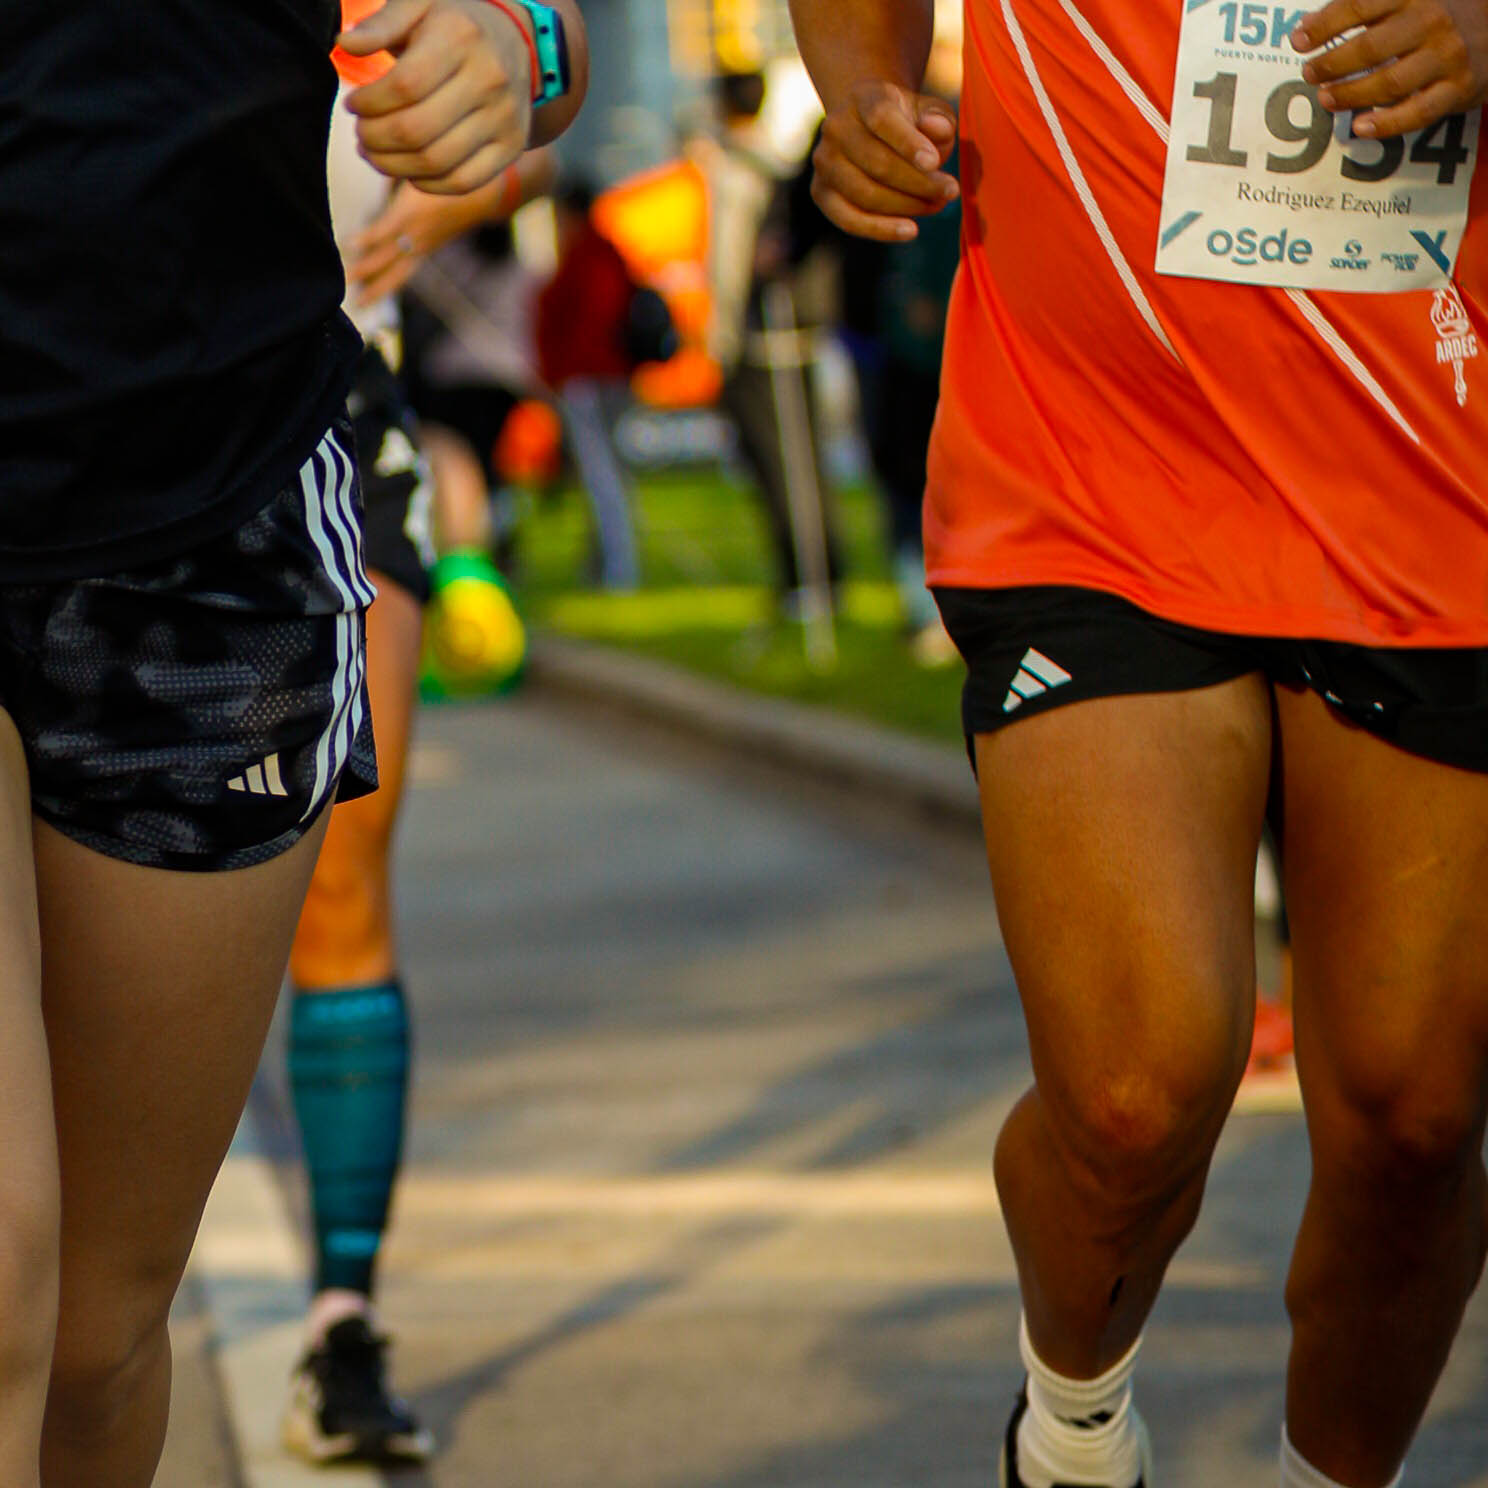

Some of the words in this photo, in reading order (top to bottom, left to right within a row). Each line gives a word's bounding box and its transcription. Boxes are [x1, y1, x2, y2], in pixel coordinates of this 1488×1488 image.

[1218, 1, 1309, 49] 15K
[1214, 47, 1254, 61] PUERTO
[1257, 53, 1291, 66] NORTE
[1186, 71, 1469, 185] 1954
[1237, 181, 1335, 212] Rodriguez
[1340, 192, 1411, 219] Ezequiel
[1435, 333, 1479, 364] ARDEC
